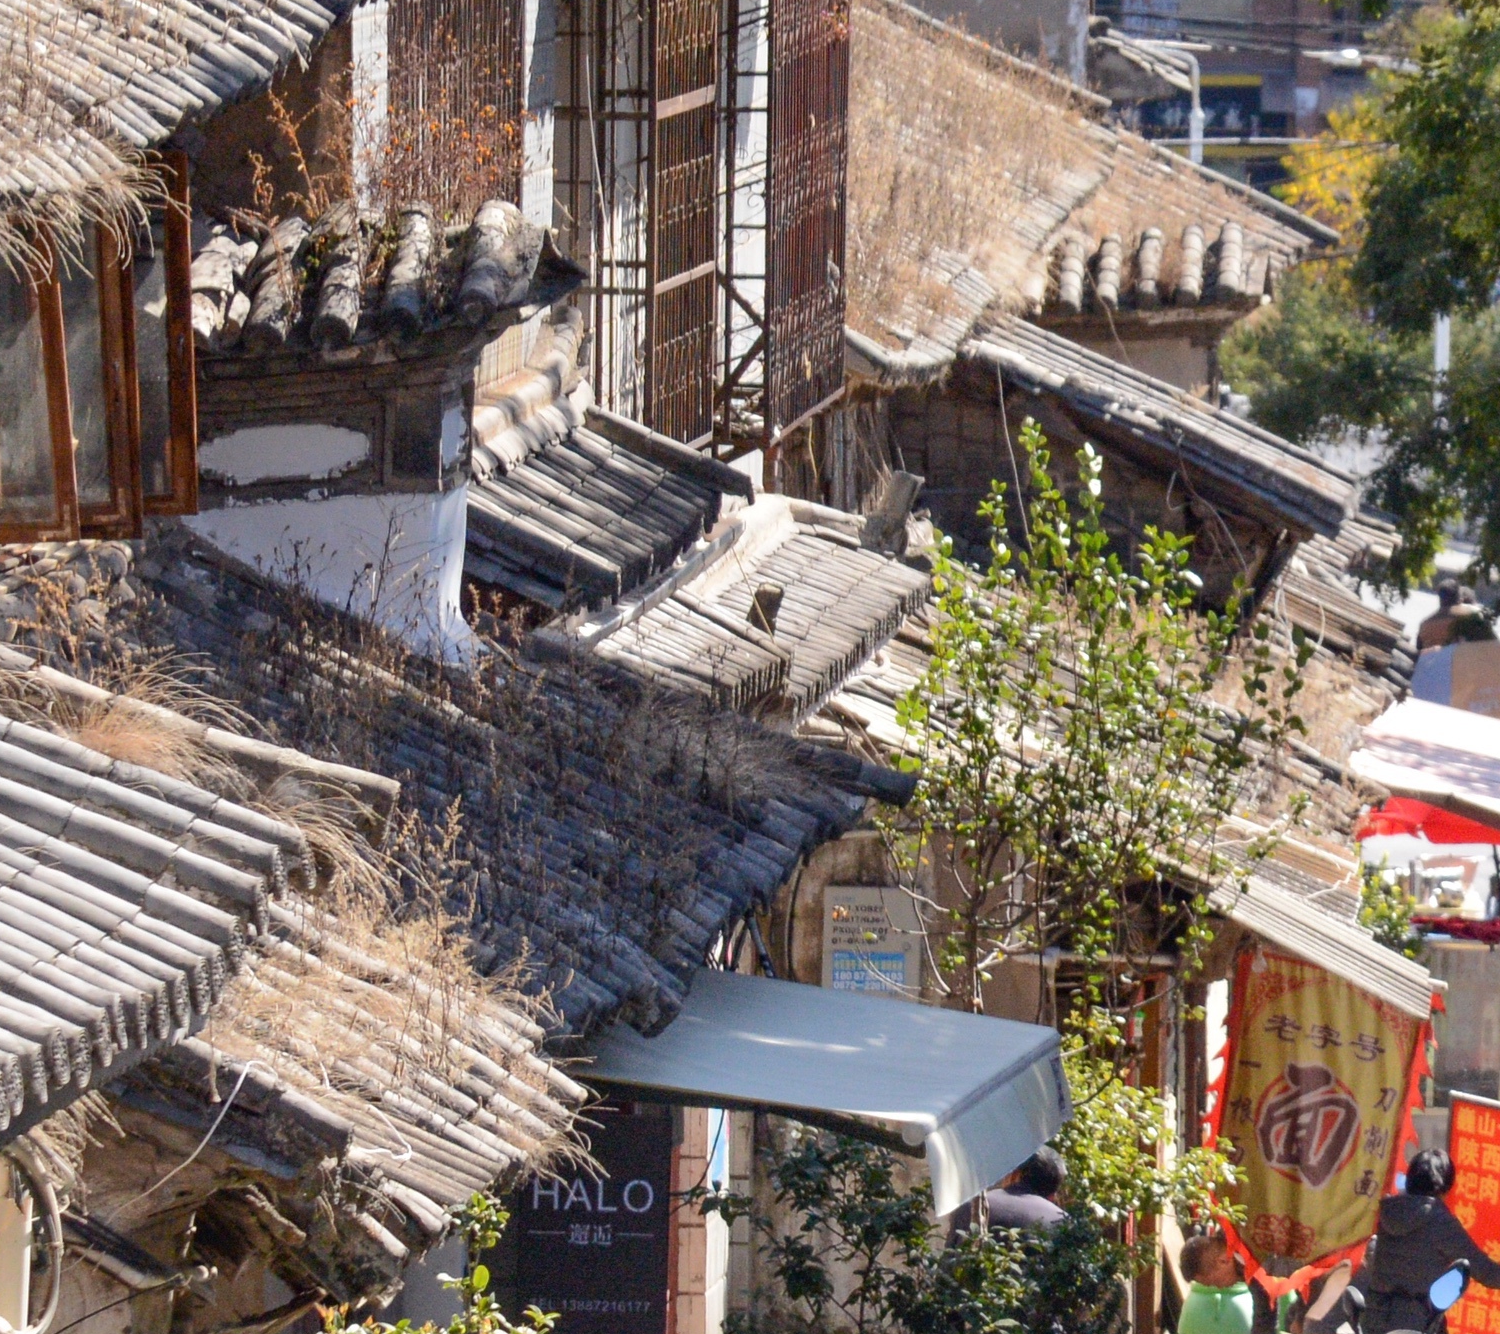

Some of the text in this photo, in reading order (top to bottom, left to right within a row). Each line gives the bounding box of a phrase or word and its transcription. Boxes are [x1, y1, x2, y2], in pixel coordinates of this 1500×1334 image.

[1264, 1014, 1387, 1063] 老字号
[1257, 1061, 1358, 1190] 面
[1353, 1087, 1398, 1198] 刀削面
[532, 1177, 654, 1213] HALO
